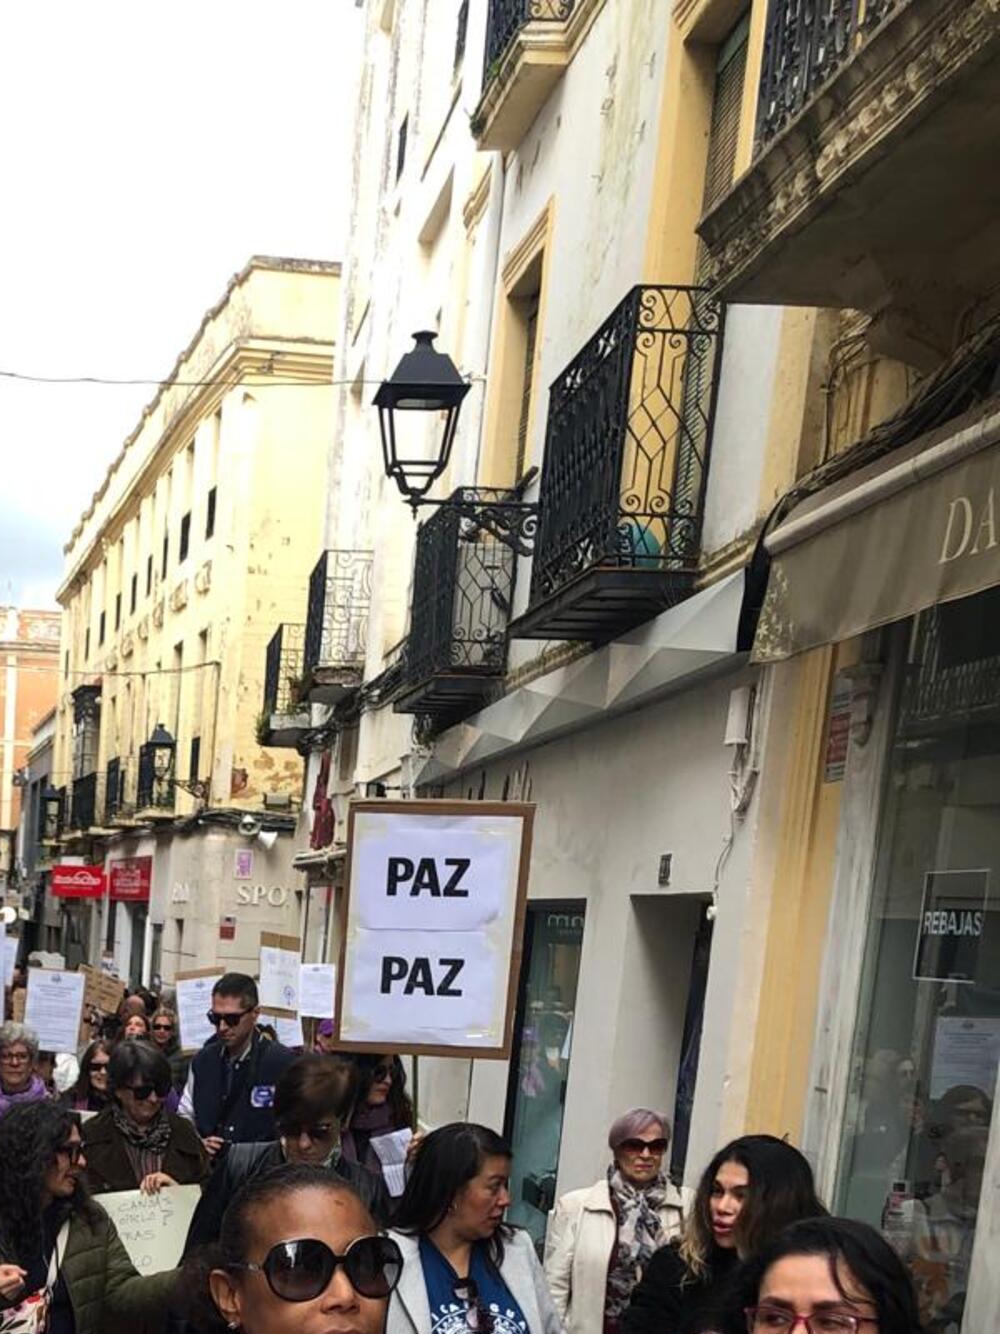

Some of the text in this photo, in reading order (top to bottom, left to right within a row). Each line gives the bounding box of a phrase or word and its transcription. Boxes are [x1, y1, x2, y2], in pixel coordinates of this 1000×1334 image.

[386, 857, 471, 898] PAZ
[923, 911, 982, 937] REBAJAS
[380, 956, 465, 997] PAZ
